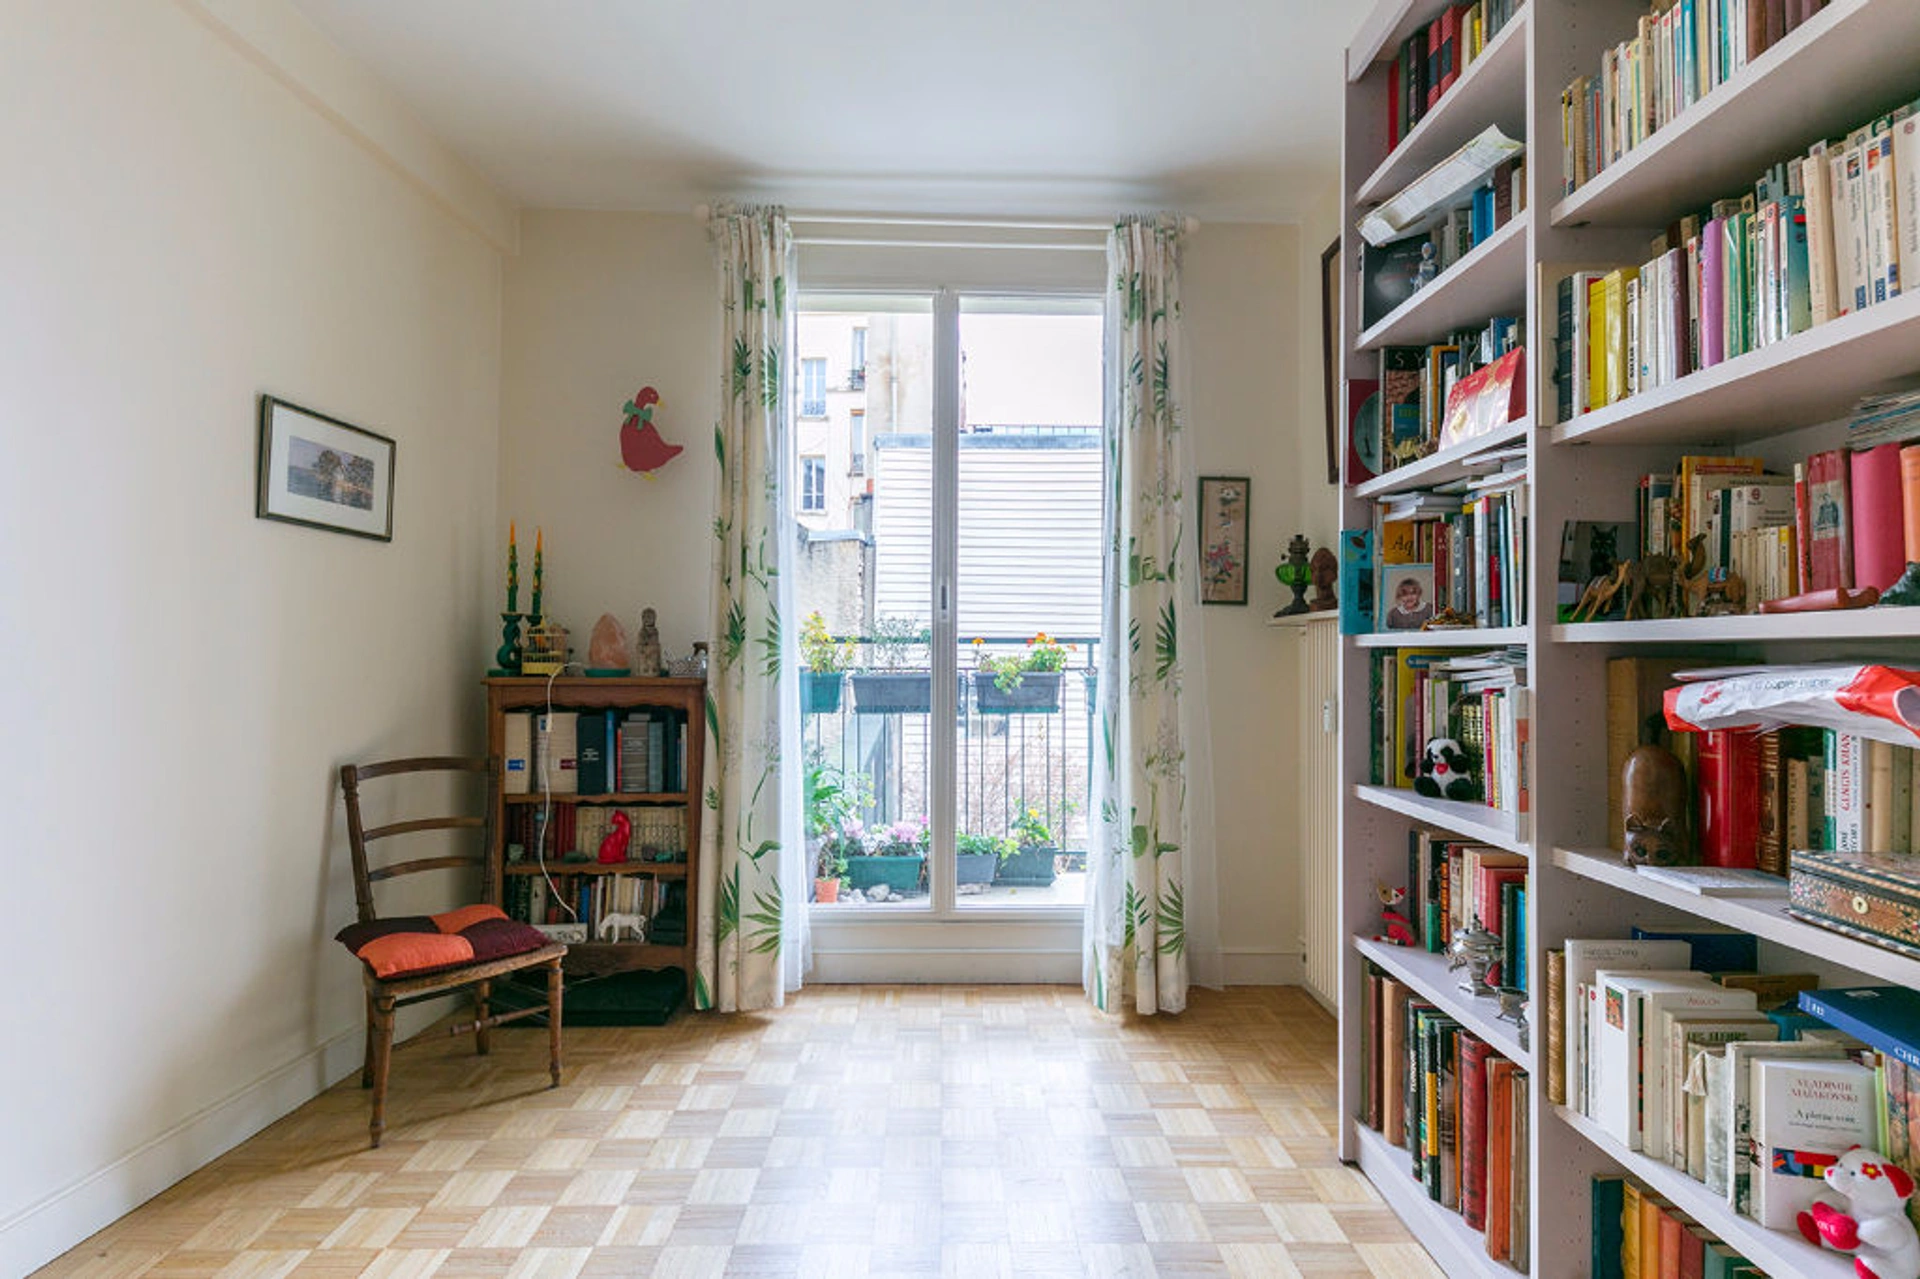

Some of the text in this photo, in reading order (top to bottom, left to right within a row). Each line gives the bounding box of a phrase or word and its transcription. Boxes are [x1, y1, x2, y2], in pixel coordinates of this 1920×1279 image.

[1841, 733, 1850, 811] GENGIS KHAN
[1797, 1079, 1852, 1092] VLADIMIR
